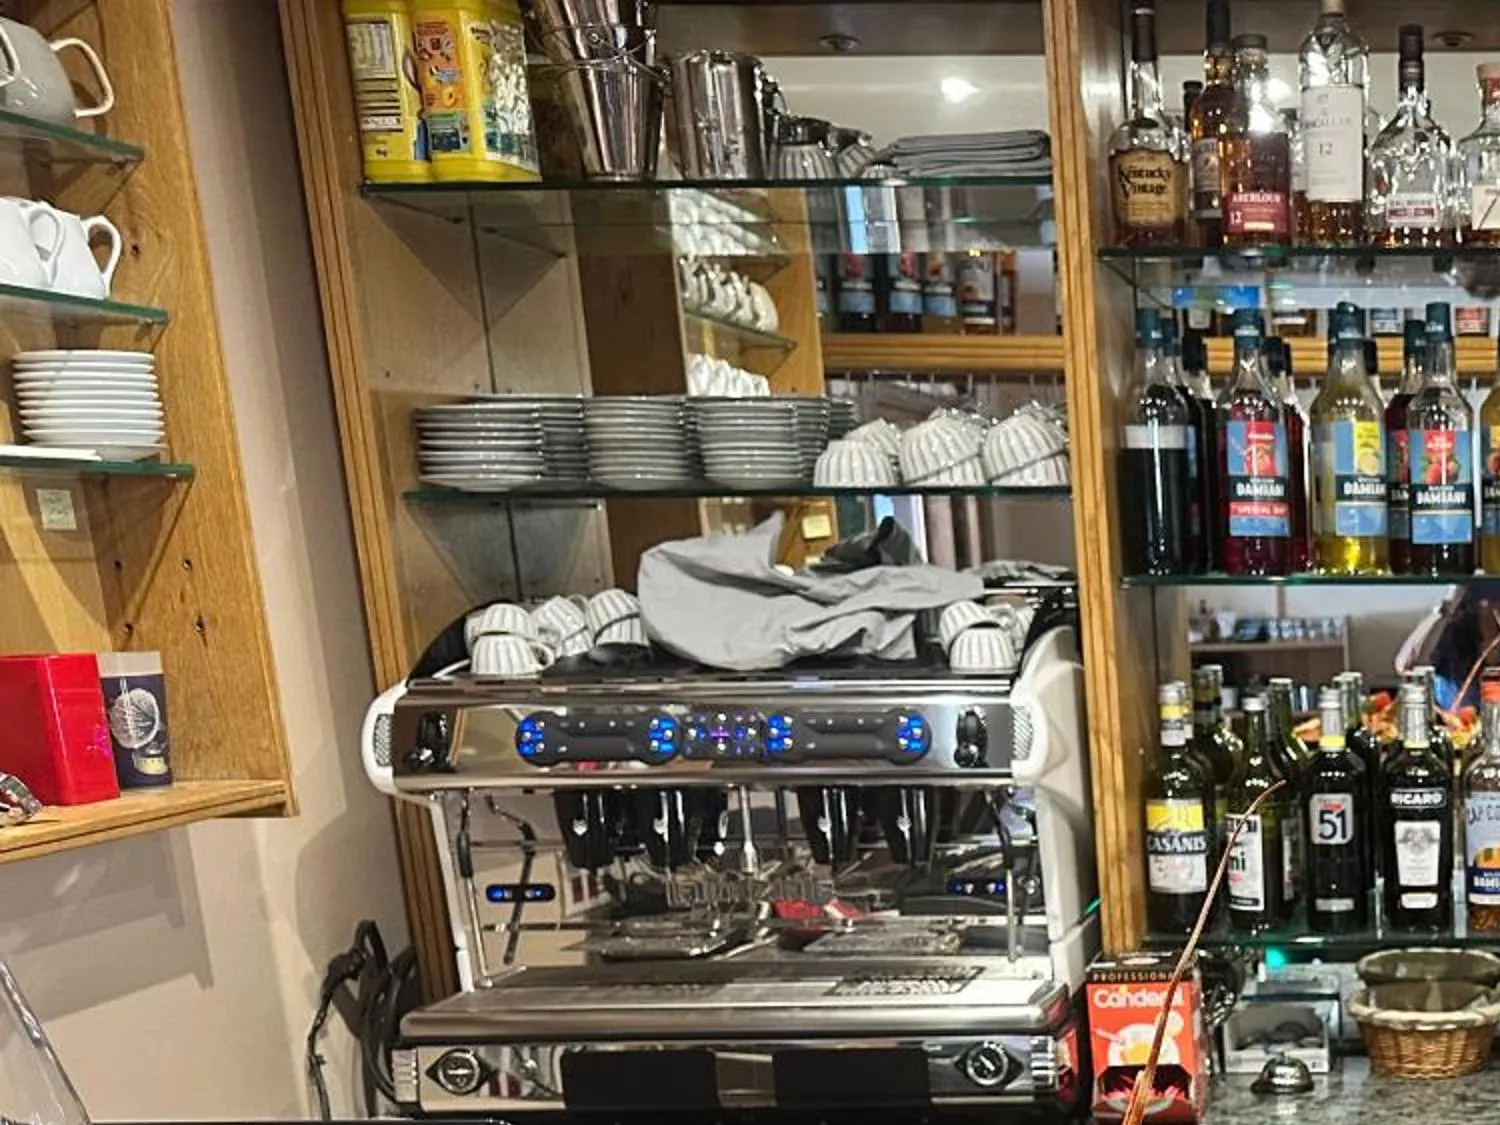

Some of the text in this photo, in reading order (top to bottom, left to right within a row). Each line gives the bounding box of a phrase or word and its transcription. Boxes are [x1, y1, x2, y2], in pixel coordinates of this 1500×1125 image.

[1391, 792, 1443, 806] RICARD
[1318, 808, 1347, 840] 51
[1093, 970, 1184, 982] PROFESSIONA
